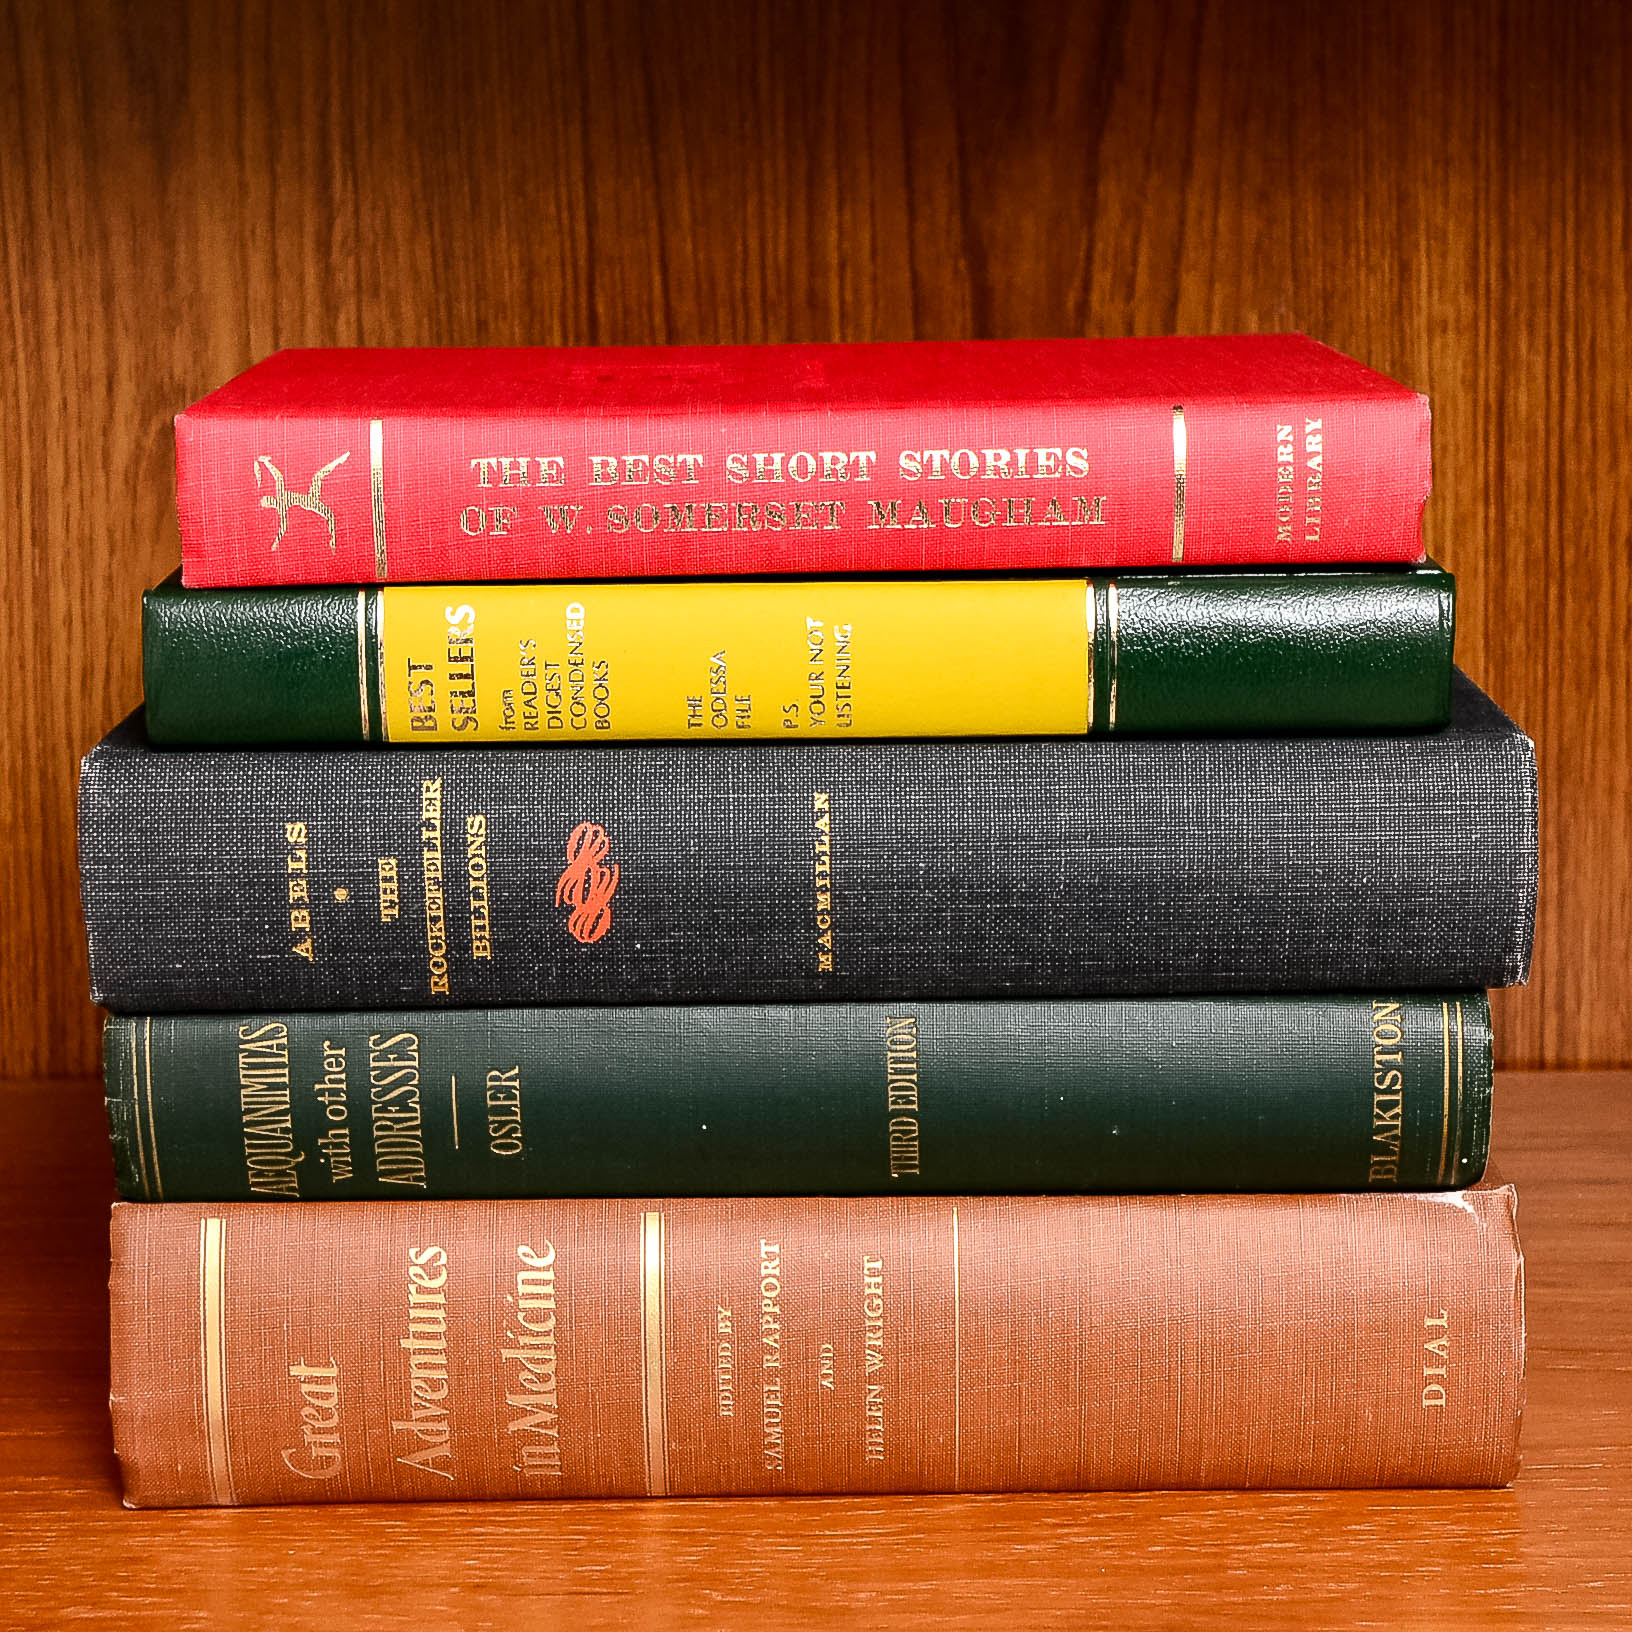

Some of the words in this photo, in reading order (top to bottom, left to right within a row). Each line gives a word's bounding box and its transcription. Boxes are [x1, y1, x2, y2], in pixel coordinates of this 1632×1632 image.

[471, 457, 565, 488] THE
[588, 454, 704, 486] BEST
[725, 450, 878, 485] SHORT
[898, 447, 1090, 481] STORIES
[1276, 424, 1294, 543] MODERN
[1305, 417, 1324, 543] LIBRARY
[460, 505, 518, 536] OF
[541, 504, 593, 536] W.
[606, 499, 846, 535] SOMERSET
[867, 495, 1108, 530] MAUGHAM
[445, 604, 480, 732] SELLERS
[520, 638, 538, 732] READER'S
[566, 602, 588, 732] CONDENSED
[806, 616, 824, 666] NOT
[836, 623, 854, 729] LISTENING
[408, 657, 439, 732] BEST
[500, 689, 517, 732] from
[545, 660, 564, 732] DIGEST
[594, 659, 612, 731] BOOKS
[687, 694, 704, 730] THE
[712, 649, 729, 729] ODESSA
[735, 694, 753, 730] FILE
[808, 670, 825, 729] YOUR
[286, 821, 314, 961] ABELS
[378, 857, 401, 922] THE
[422, 777, 450, 995] ROCKEFELLER
[467, 813, 492, 960] BILLIONS
[813, 791, 835, 972] MACMILLAN
[313, 1040, 349, 1121] other
[486, 1064, 521, 1157] OSLER
[886, 1015, 920, 1113] EDITION
[1367, 999, 1403, 1184] BLAKISTON
[319, 1123, 352, 1184] with
[368, 1032, 428, 1190] ADDRESSES
[890, 1115, 920, 1179] THIRD
[500, 1238, 559, 1438] Medicine
[717, 1304, 734, 1335] BY
[760, 1238, 781, 1370] RAPPORT
[863, 1255, 884, 1374] WRIGHT
[391, 1244, 456, 1482] Adventures
[718, 1341, 734, 1418] EDITED
[820, 1342, 835, 1391] AND
[1421, 1307, 1450, 1409] DIAL
[281, 1356, 342, 1481] Great
[513, 1443, 562, 1478] in
[762, 1376, 783, 1472] SAMUEL
[865, 1384, 885, 1462] HELEN
